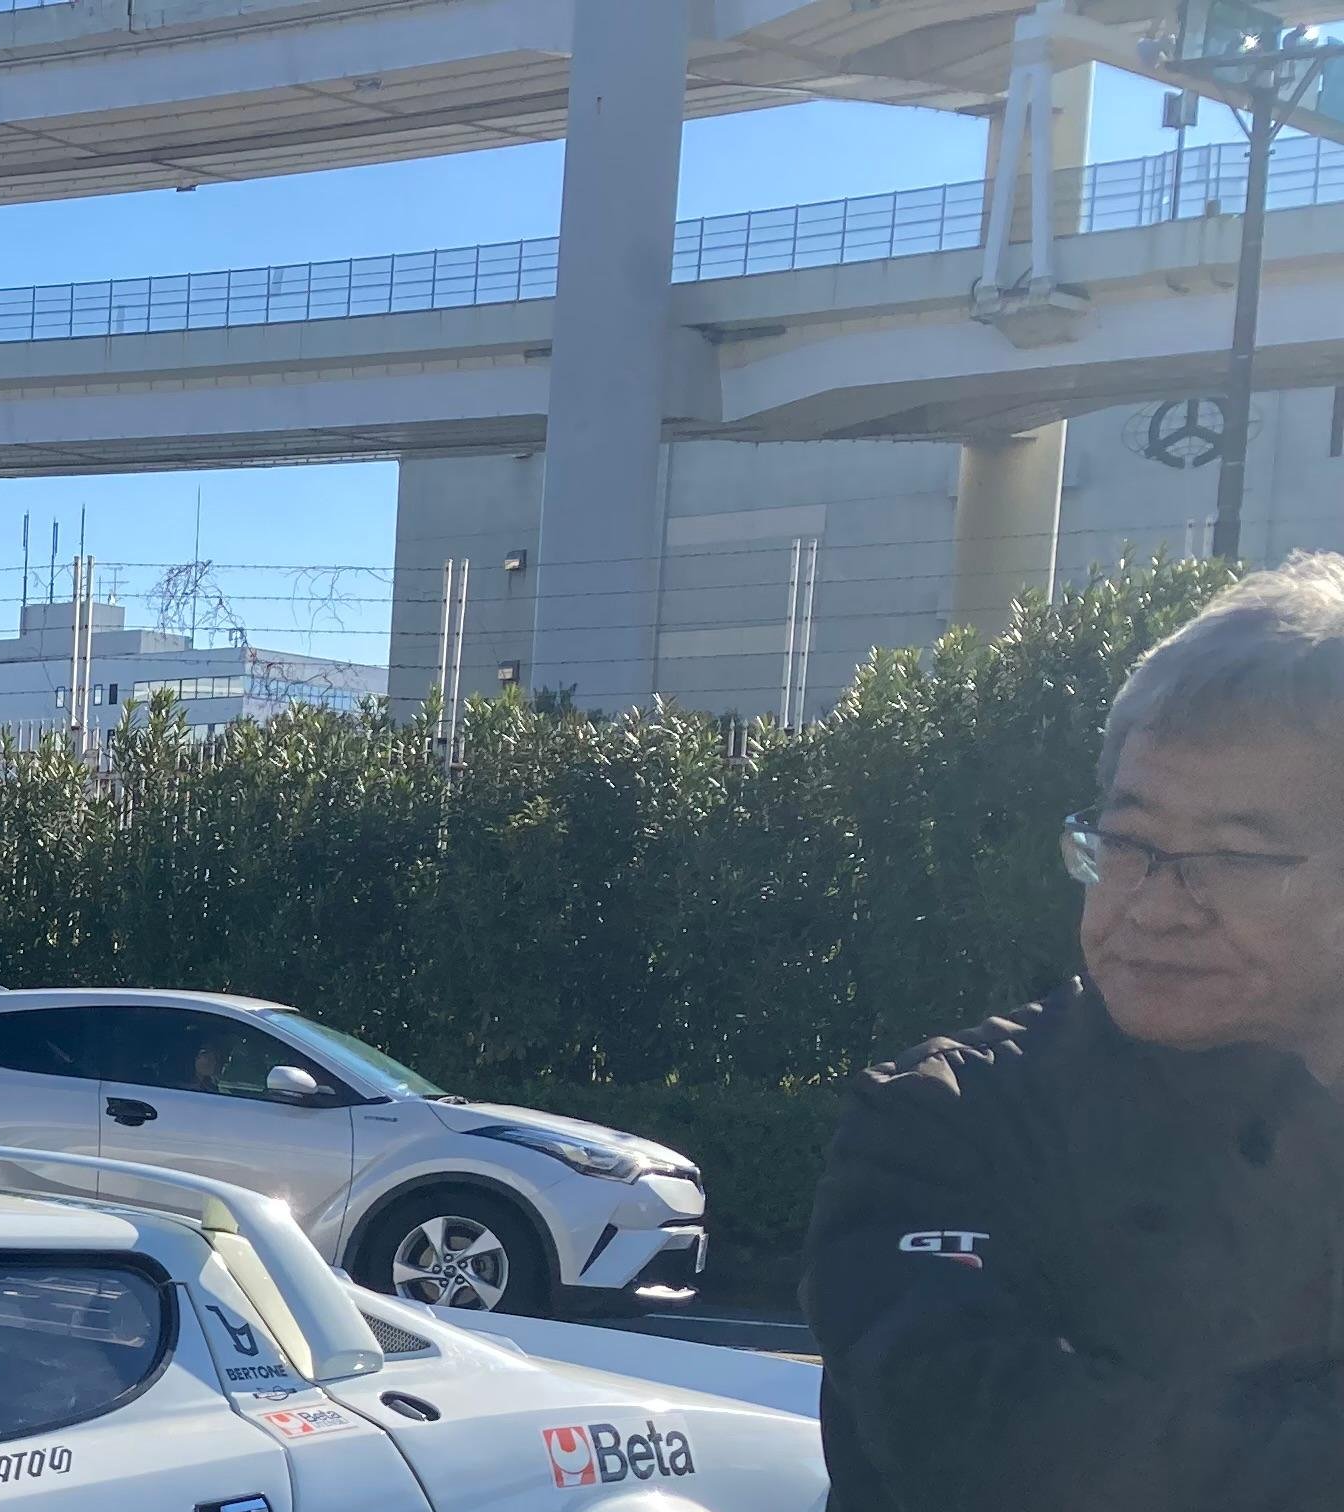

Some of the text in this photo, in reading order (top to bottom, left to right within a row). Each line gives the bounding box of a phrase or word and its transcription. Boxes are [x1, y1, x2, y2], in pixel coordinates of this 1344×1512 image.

[899, 1231, 990, 1252] GT
[225, 1364, 289, 1382] BERTONE
[588, 1420, 696, 1483] Beta
